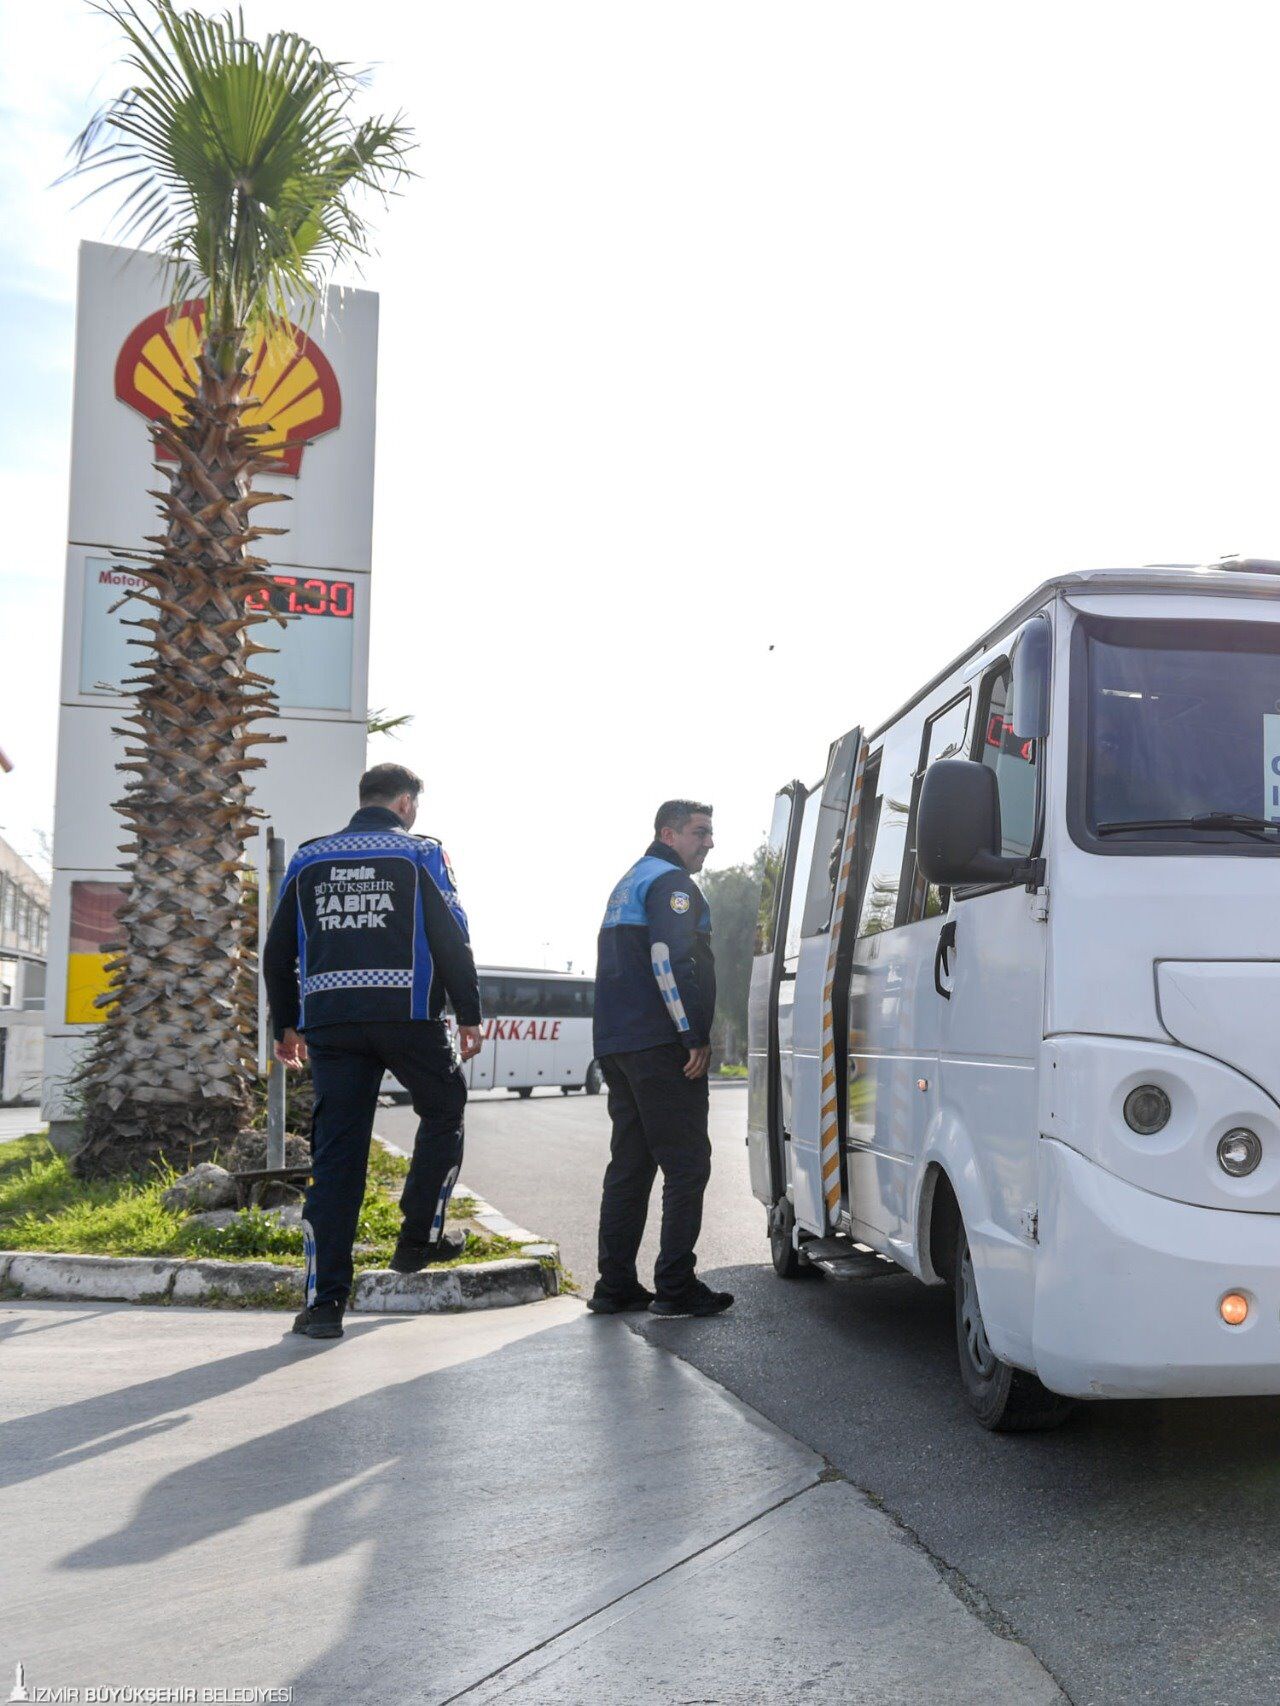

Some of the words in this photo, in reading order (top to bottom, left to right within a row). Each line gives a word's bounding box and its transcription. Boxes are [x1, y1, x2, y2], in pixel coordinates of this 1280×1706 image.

[330, 866, 376, 881] İZMİR
[314, 879, 396, 896] BÜYÜKŞEHİR
[315, 893, 395, 916] ZABITA
[319, 911, 387, 931] TRAFİK
